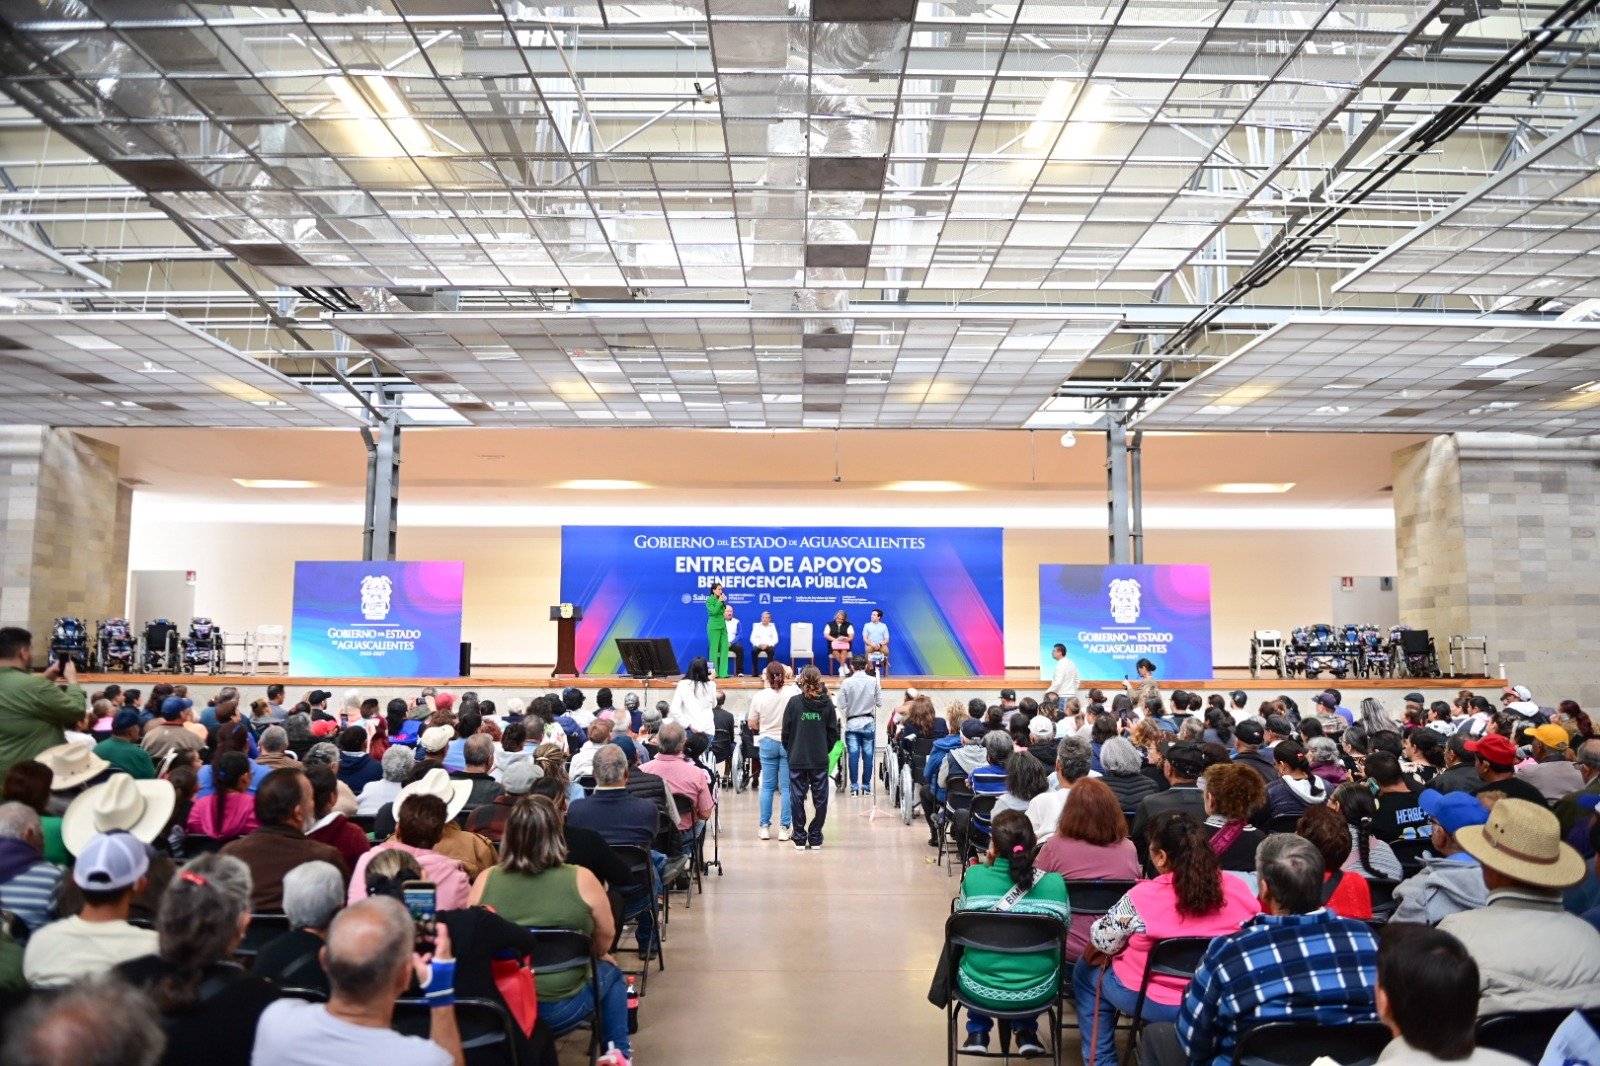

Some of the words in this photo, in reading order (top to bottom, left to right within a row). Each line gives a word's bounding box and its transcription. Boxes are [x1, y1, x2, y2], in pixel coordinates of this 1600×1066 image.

[633, 534, 715, 549] GOBIERNO
[730, 536, 788, 549] ESTADO
[799, 535, 926, 550] AGUASCALIENTES
[675, 555, 765, 573] ENTREGA
[768, 555, 794, 573] DE
[798, 555, 883, 574] APOYOS
[697, 575, 803, 589] BENEFICENCIA
[805, 573, 868, 589] PÚBLICA
[692, 593, 709, 601] Salu
[327, 627, 376, 639] GOBIERNO
[385, 629, 421, 639] ESTADO
[1077, 631, 1128, 642] GOBIERNO
[1137, 632, 1174, 643] ESTADO
[337, 640, 415, 651] AGUASCALIENTES
[1089, 643, 1167, 654] AGUASCALIENTES
[1395, 806, 1427, 824] HERBE
